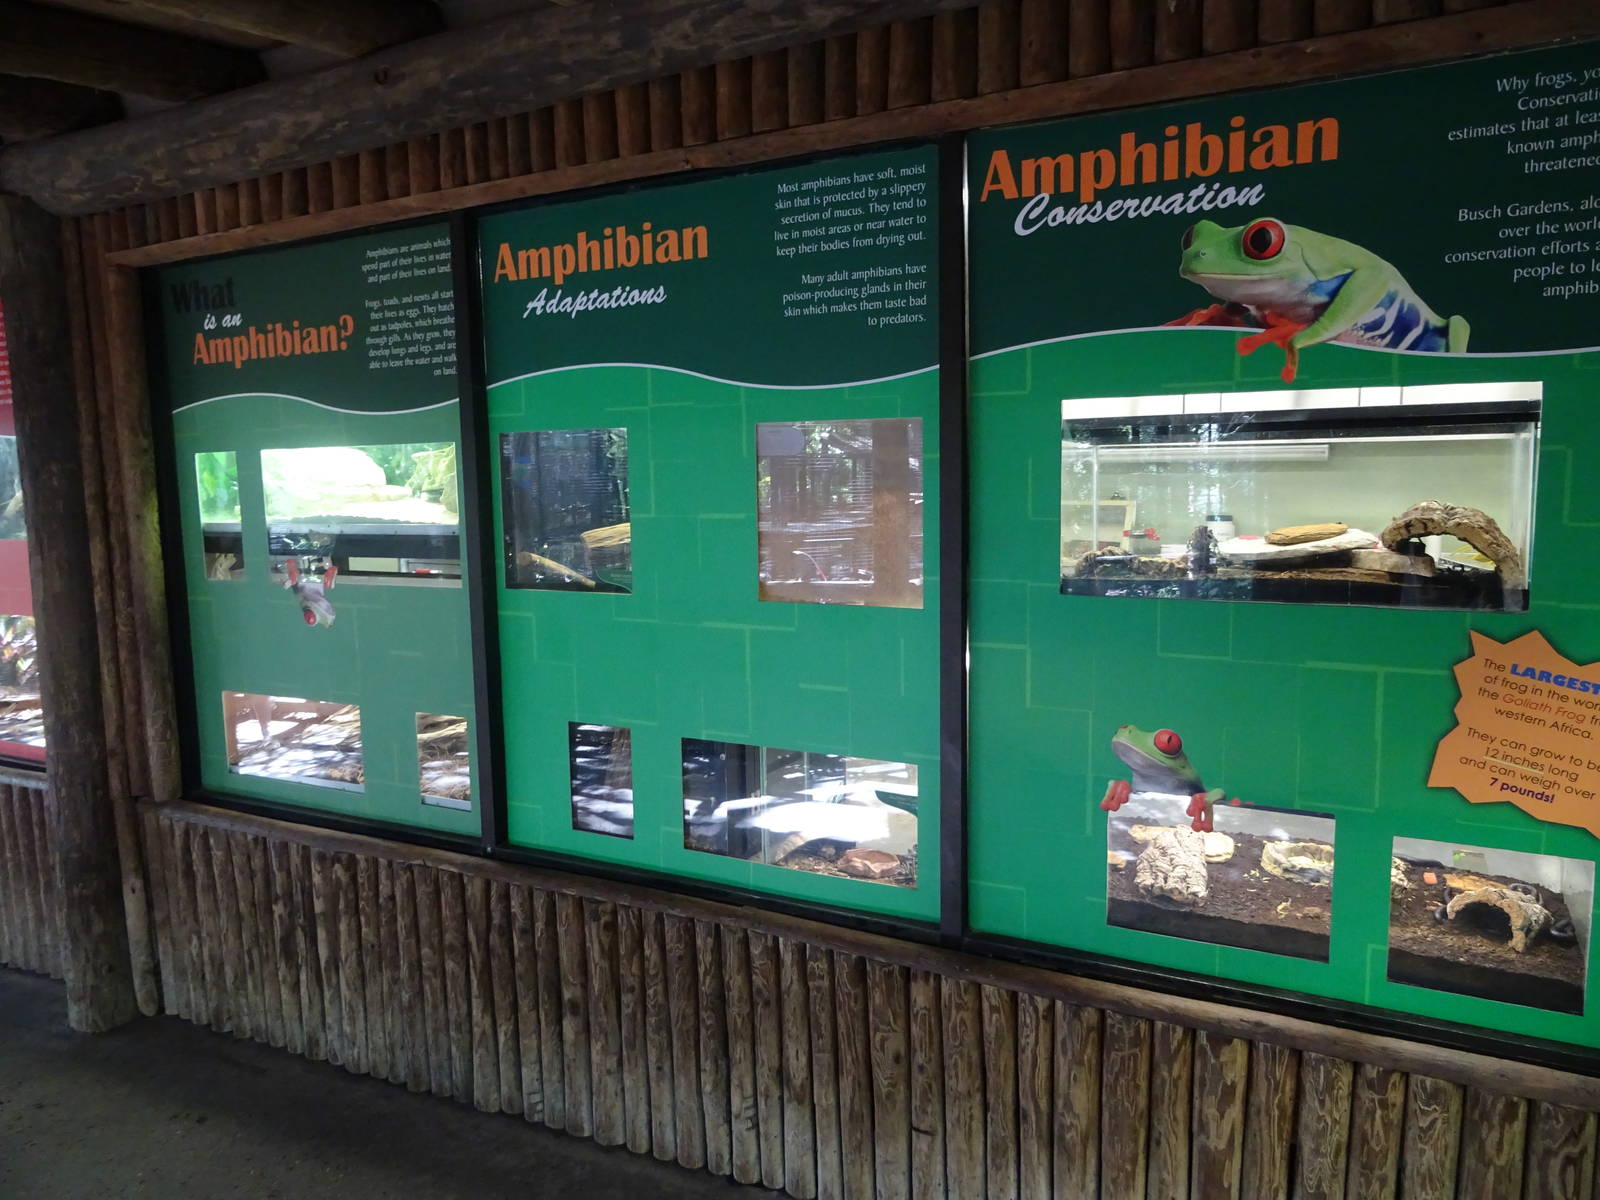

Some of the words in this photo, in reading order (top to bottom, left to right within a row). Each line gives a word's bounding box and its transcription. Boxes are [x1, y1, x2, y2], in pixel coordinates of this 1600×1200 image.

[1496, 76, 1530, 94] Why
[1517, 88, 1600, 111] Conservati
[1448, 122, 1516, 141] estimates
[1521, 116, 1549, 131] that
[1555, 114, 1568, 127] at
[980, 115, 1340, 203] Amphibian
[1507, 139, 1555, 155] known
[777, 183, 799, 194] Most
[801, 176, 851, 192] amphibians
[853, 171, 874, 184] have
[900, 163, 926, 177] moist
[774, 200, 792, 210] skin
[794, 197, 811, 208] that
[813, 195, 821, 205] is
[823, 188, 866, 207] protected
[868, 187, 879, 200] by
[881, 188, 887, 196] a
[889, 182, 926, 197] slippery
[1013, 180, 1266, 237] Conservation
[781, 212, 820, 225] secretion
[822, 208, 832, 219] of
[834, 208, 865, 218] mucus.
[869, 203, 890, 215] They
[893, 198, 914, 210] tend
[916, 198, 927, 208] to
[1458, 205, 1501, 222] Busch
[774, 230, 789, 241] live
[791, 228, 800, 239] in
[802, 226, 826, 238] moist
[828, 224, 851, 235] areas
[853, 223, 863, 231] or
[866, 221, 886, 230] near
[888, 216, 913, 227] water
[916, 215, 927, 224] to
[1499, 225, 1530, 238] over
[1536, 221, 1560, 236] the
[1564, 216, 1600, 232] worl
[494, 222, 709, 286] Amphibian
[776, 245, 797, 258] keep
[798, 243, 818, 254] their
[821, 239, 850, 251] bodies
[852, 236, 874, 248] from
[876, 232, 905, 248] drying
[907, 230, 926, 241] out.
[1444, 245, 1536, 264] conservation
[1541, 240, 1590, 256] efforts
[801, 273, 825, 287] Many
[826, 270, 850, 281] adult
[851, 265, 903, 282] amphibians
[905, 263, 927, 274] have
[1513, 261, 1565, 283] people
[1570, 262, 1586, 275] to
[522, 285, 668, 319] Adaptations
[783, 286, 860, 305] poison-producing
[861, 283, 891, 298] glands
[893, 281, 902, 291] in
[905, 279, 927, 291] their
[784, 306, 801, 318] skin
[802, 303, 828, 315] which
[830, 300, 858, 313] makes
[860, 299, 882, 311] them
[885, 297, 907, 308] taste
[909, 295, 927, 306] bad
[203, 313, 218, 331] is
[221, 312, 243, 328] an
[868, 315, 877, 326] to
[879, 313, 927, 328] predators.
[193, 314, 355, 369] Amphibian?
[1484, 658, 1506, 673] The
[1484, 674, 1499, 685] of
[1500, 677, 1528, 694] frog
[1531, 685, 1543, 696] in
[1547, 689, 1570, 703] the
[1478, 687, 1499, 701] the
[1502, 693, 1552, 713] Goliath
[1555, 706, 1586, 724] Frog
[1590, 715, 1600, 727] fr
[1494, 706, 1546, 728] western
[1549, 721, 1594, 740] Africa.
[1467, 727, 1497, 744] They
[1500, 738, 1526, 751] can
[1529, 746, 1565, 761] grow
[1569, 754, 1583, 767] to
[1459, 755, 1487, 770] and
[1489, 764, 1516, 778] can
[1520, 772, 1561, 791] weigh
[1564, 786, 1596, 800] over
[1485, 747, 1499, 759] 12
[1501, 751, 1545, 772] inches
[1548, 764, 1580, 782] long
[1489, 777, 1498, 787] 7
[1500, 782, 1555, 803] pounds!
